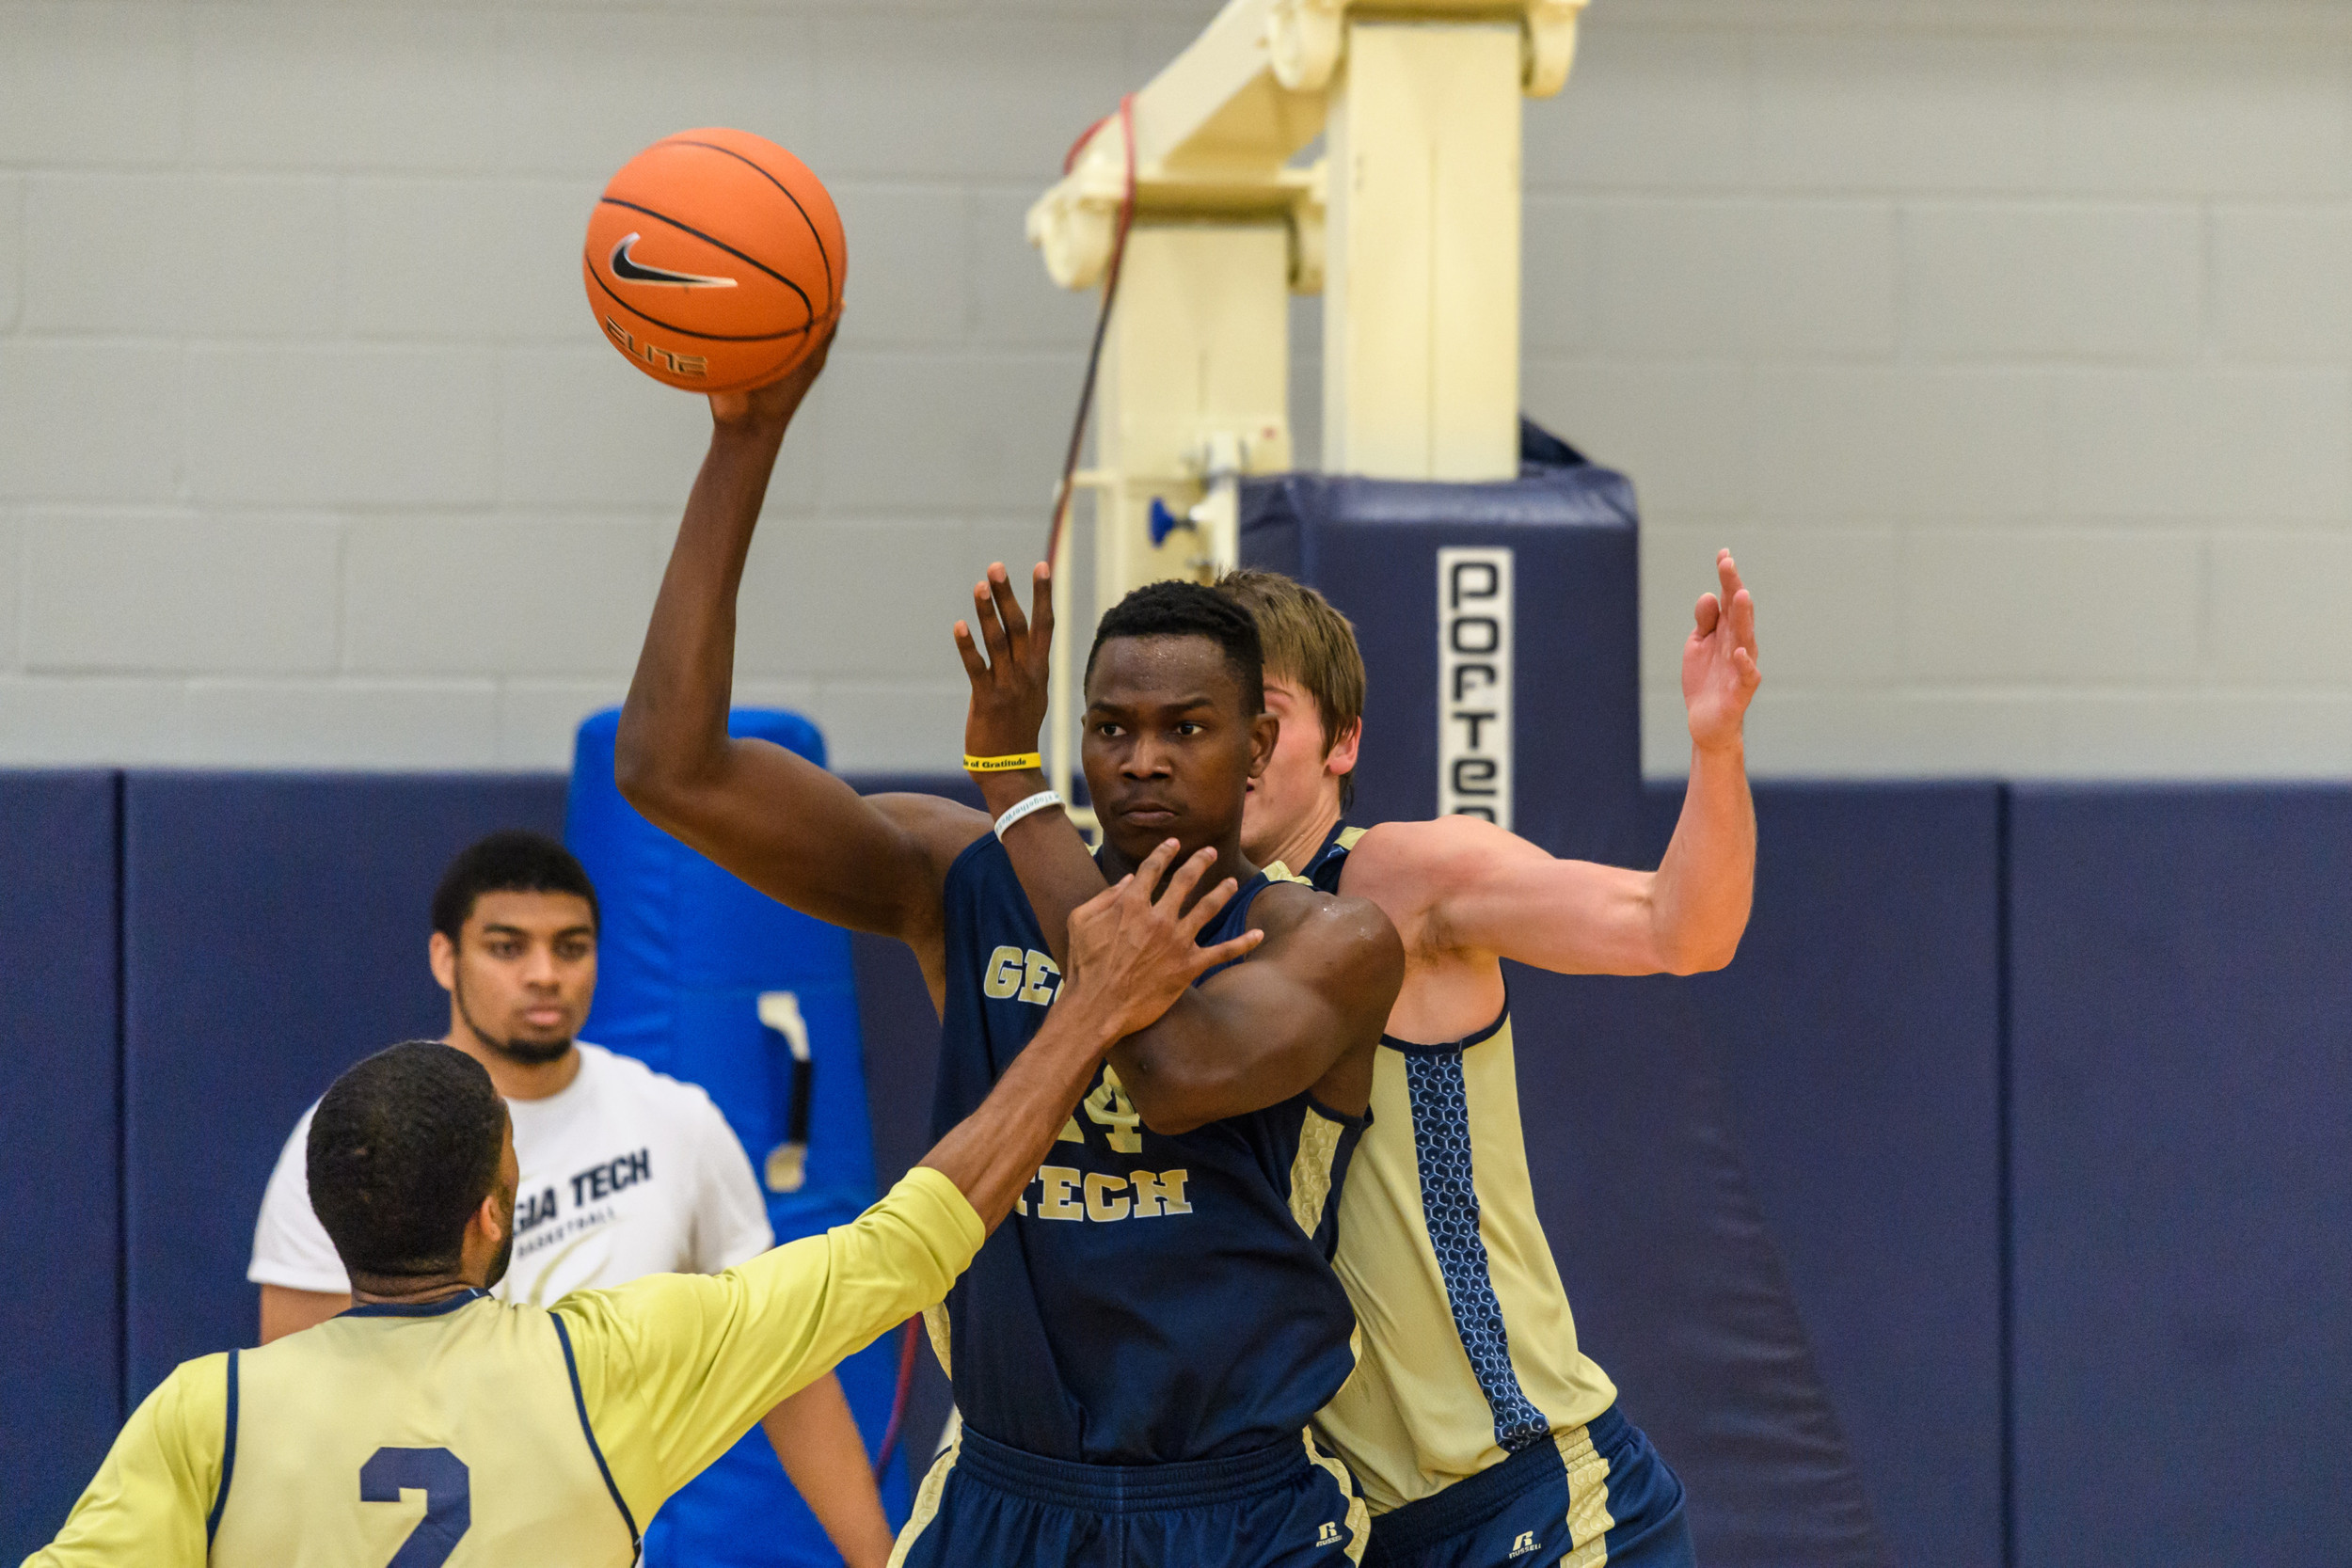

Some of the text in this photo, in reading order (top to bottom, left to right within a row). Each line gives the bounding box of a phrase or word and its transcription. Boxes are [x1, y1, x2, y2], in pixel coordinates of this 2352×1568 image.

[971, 760, 979, 768] of
[982, 757, 1026, 769] Gratitude
[984, 945, 1065, 1006] GE
[570, 1147, 652, 1208] TECH
[359, 1447, 471, 1568] 2
[1508, 1543, 1541, 1559] RUSSELL
